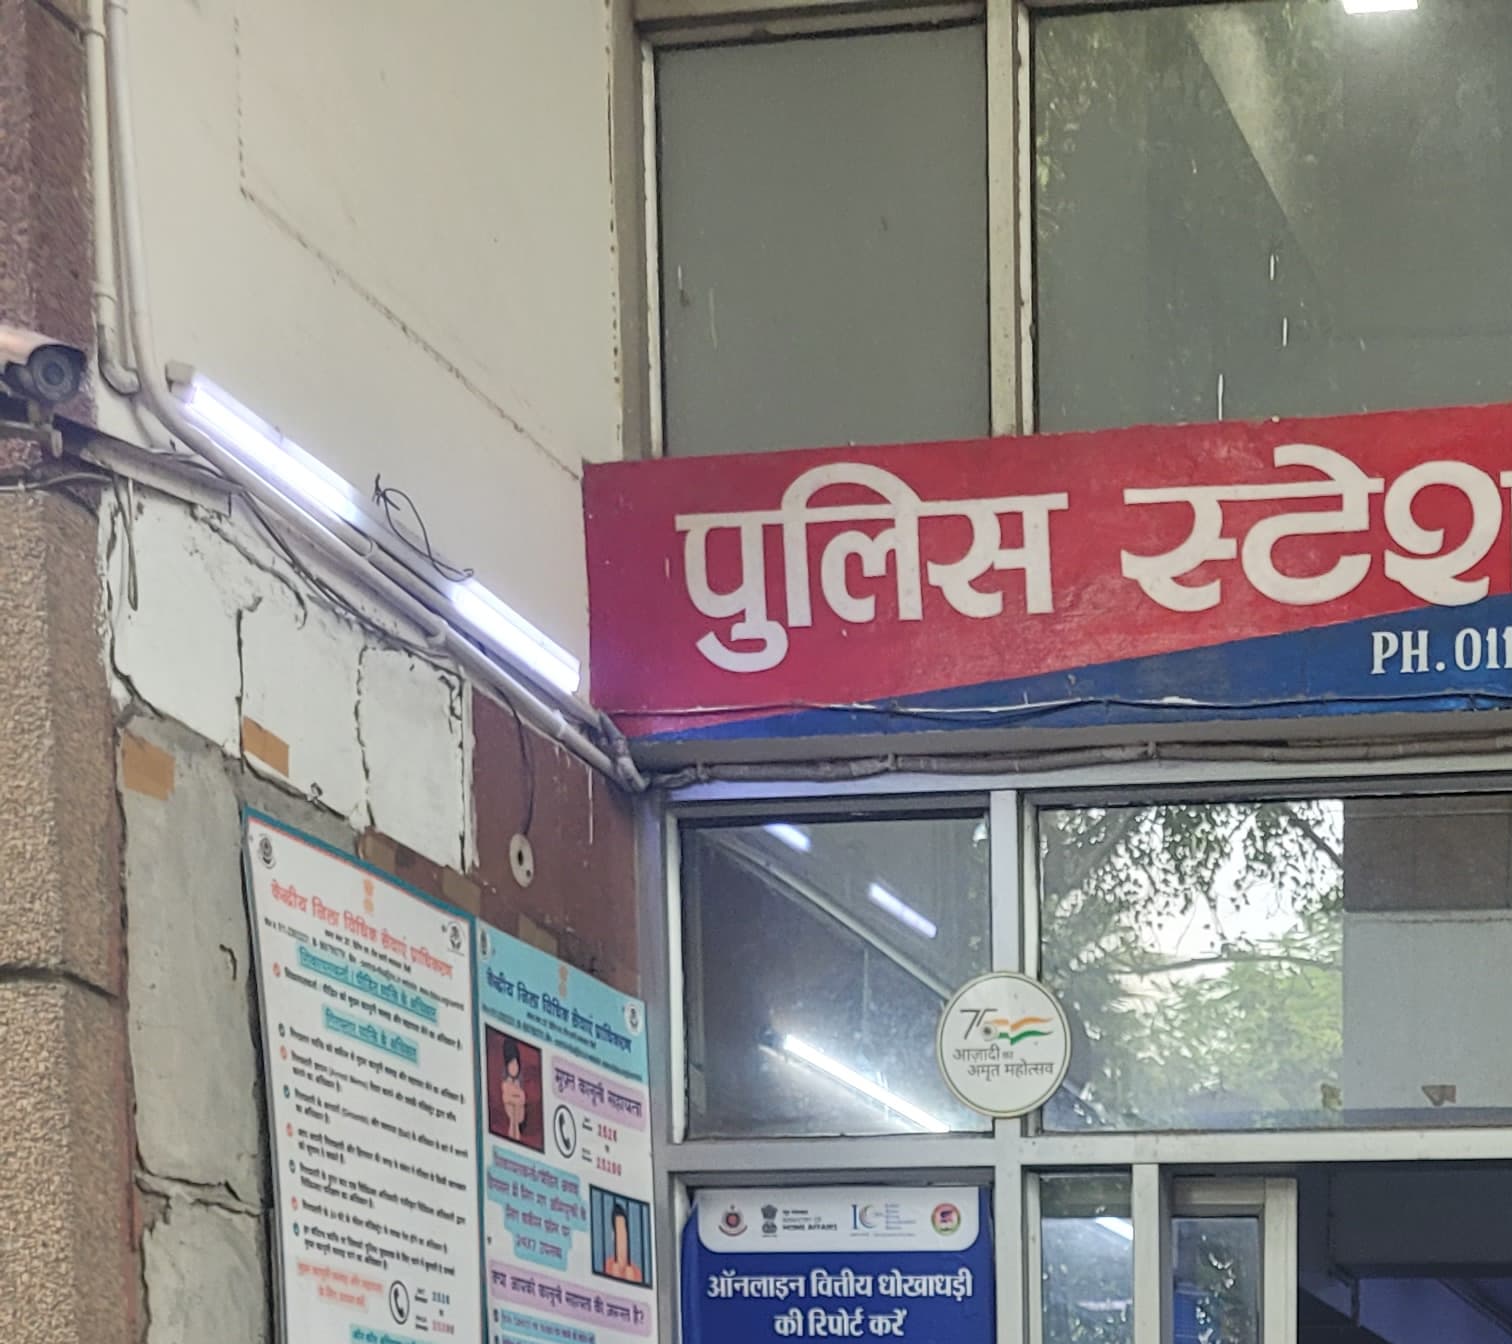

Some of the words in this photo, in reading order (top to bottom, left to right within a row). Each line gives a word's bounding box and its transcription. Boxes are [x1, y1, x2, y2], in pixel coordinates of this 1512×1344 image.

[675, 462, 1069, 673] पुलिस
[1371, 629, 1446, 675] PH.
[967, 1063, 1000, 1082] अमृत
[1004, 1059, 1055, 1078] महोत्सव
[707, 1270, 806, 1300] ऑनलाइन
[811, 1267, 873, 1298] वित्तीय
[878, 1267, 973, 1302] धोखाधड़ी
[774, 1307, 804, 1337] की
[808, 1307, 865, 1337] रिपोर्ट
[869, 1308, 908, 1337] करें
